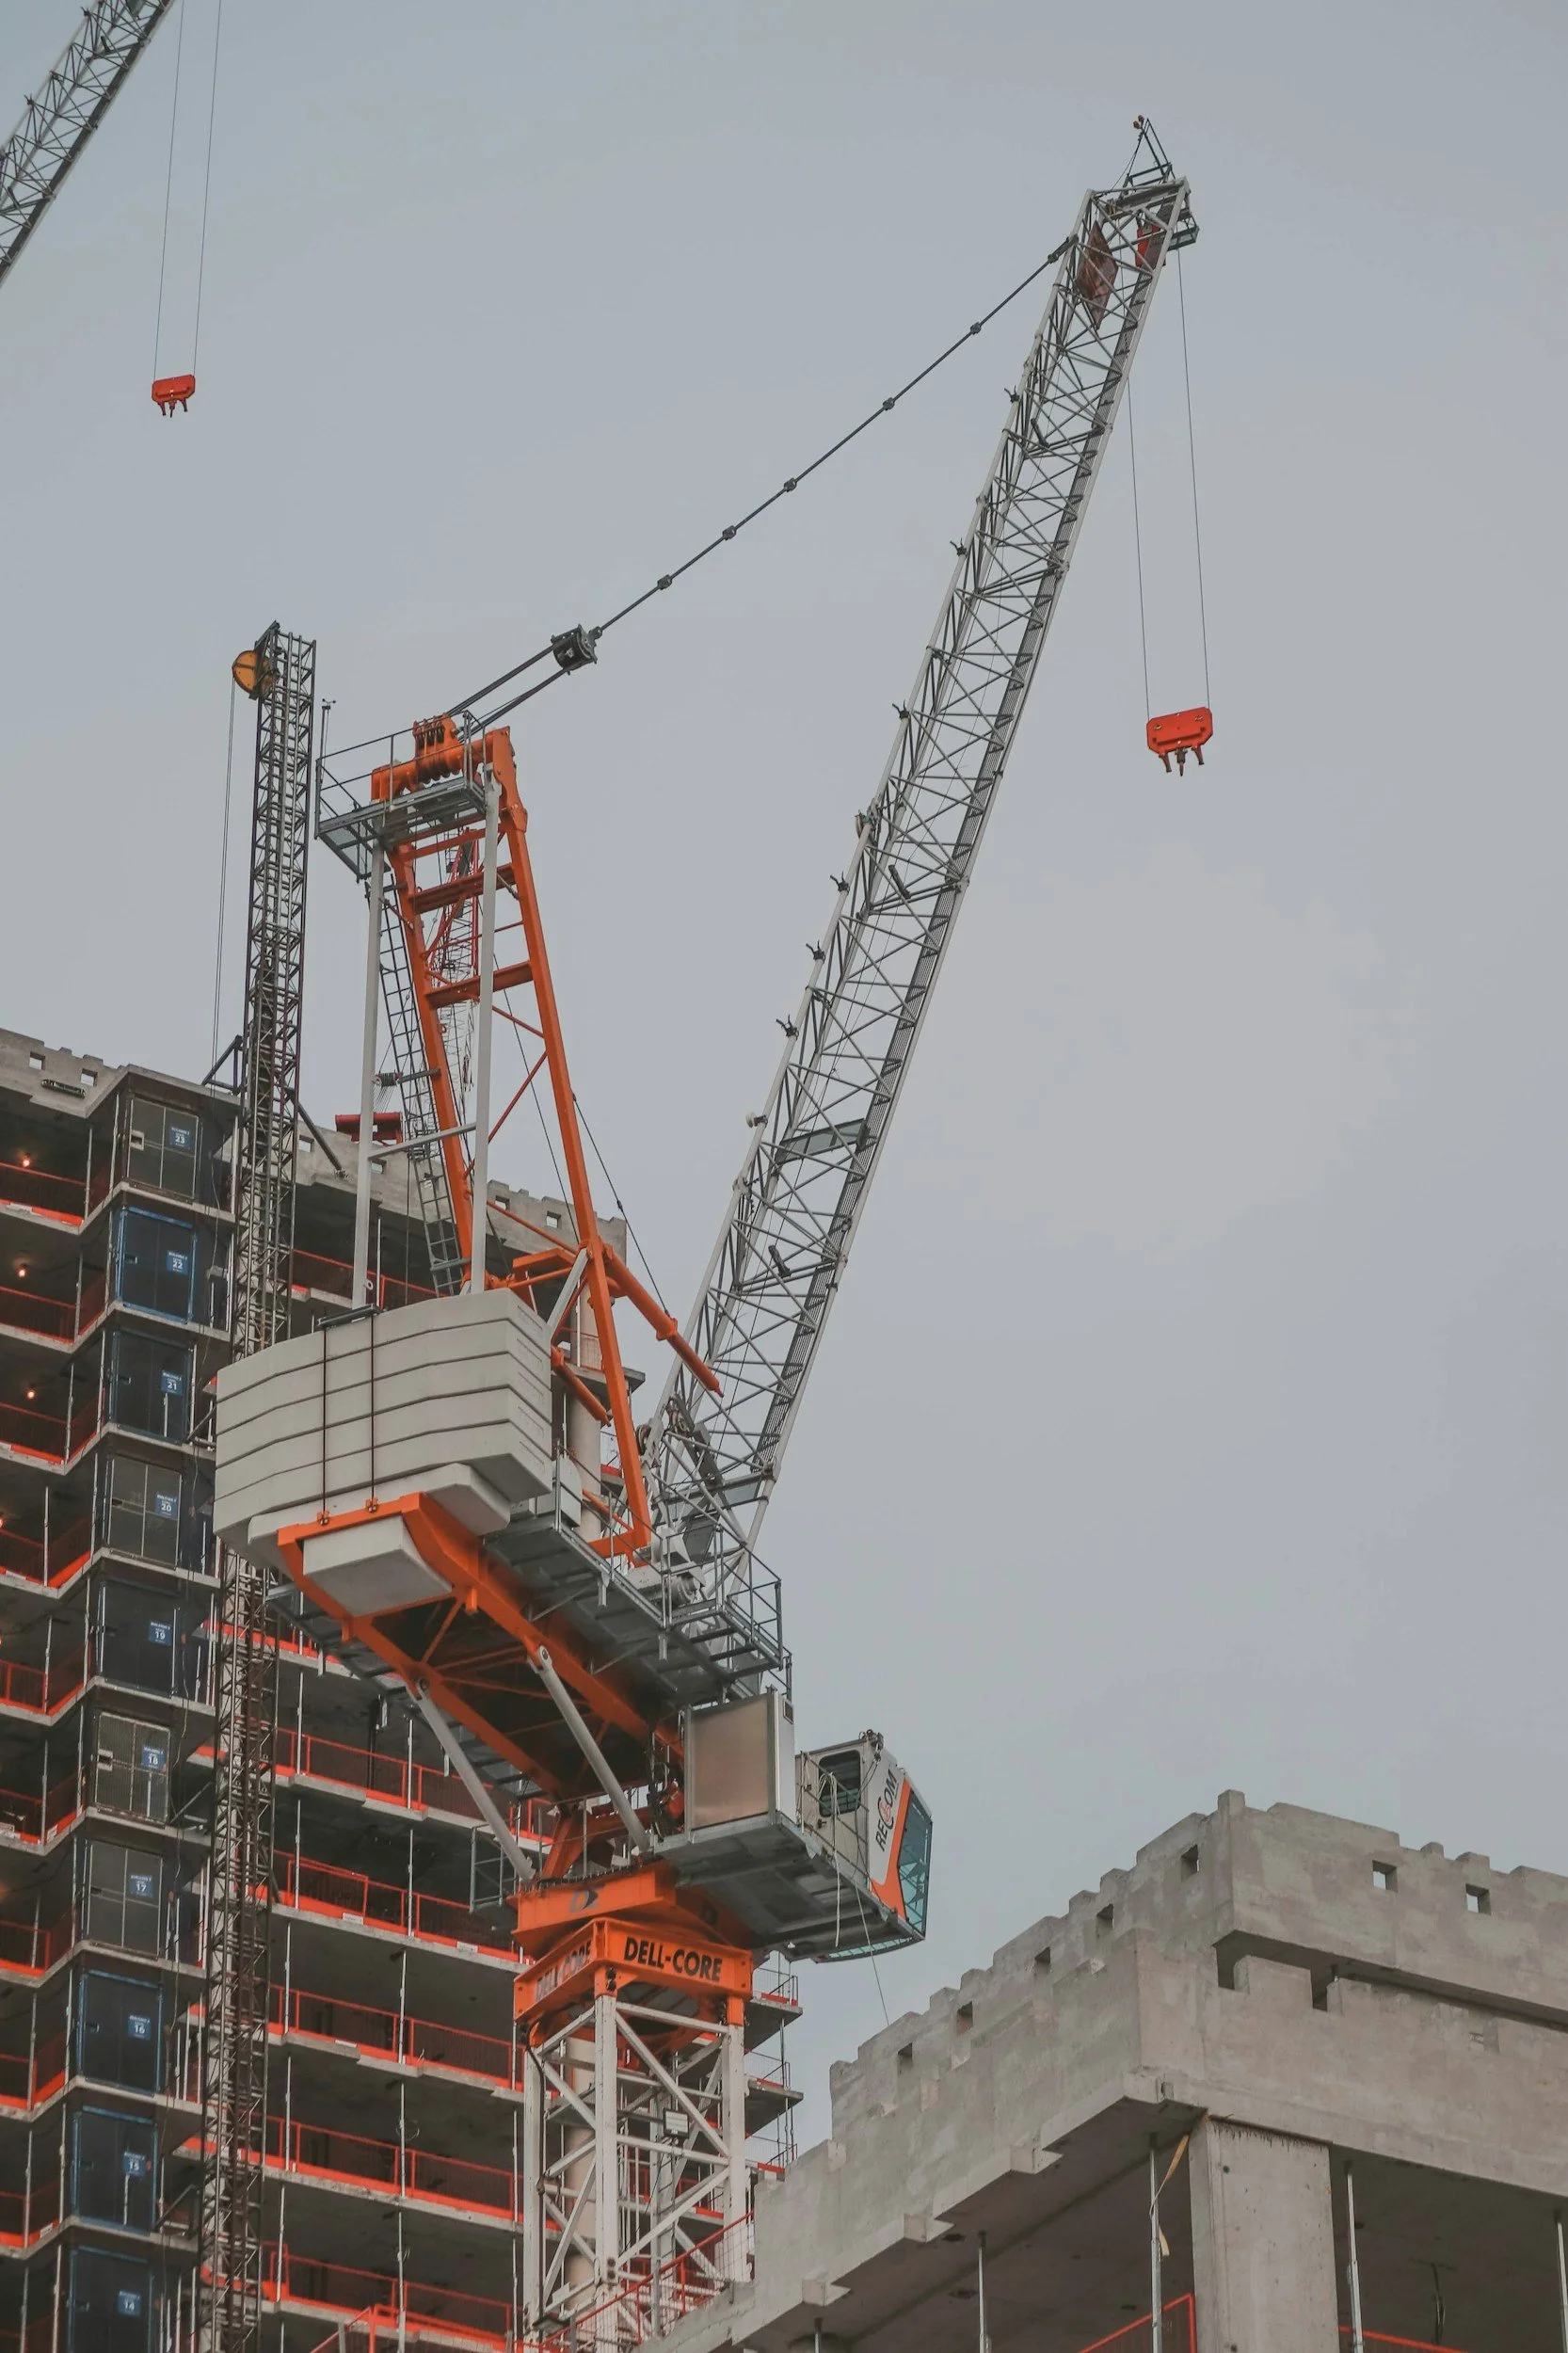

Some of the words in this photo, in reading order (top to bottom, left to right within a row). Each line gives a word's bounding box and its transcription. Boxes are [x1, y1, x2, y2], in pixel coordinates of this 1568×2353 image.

[175, 1135, 185, 1144] 23
[172, 1261, 183, 1270] 22
[167, 1381, 177, 1390] 21
[161, 1503, 172, 1512] 20
[154, 1631, 166, 1640] 19
[875, 1769, 897, 1851] RECOM
[136, 1883, 146, 1892] 17
[623, 1936, 722, 1982] DELL-CORE
